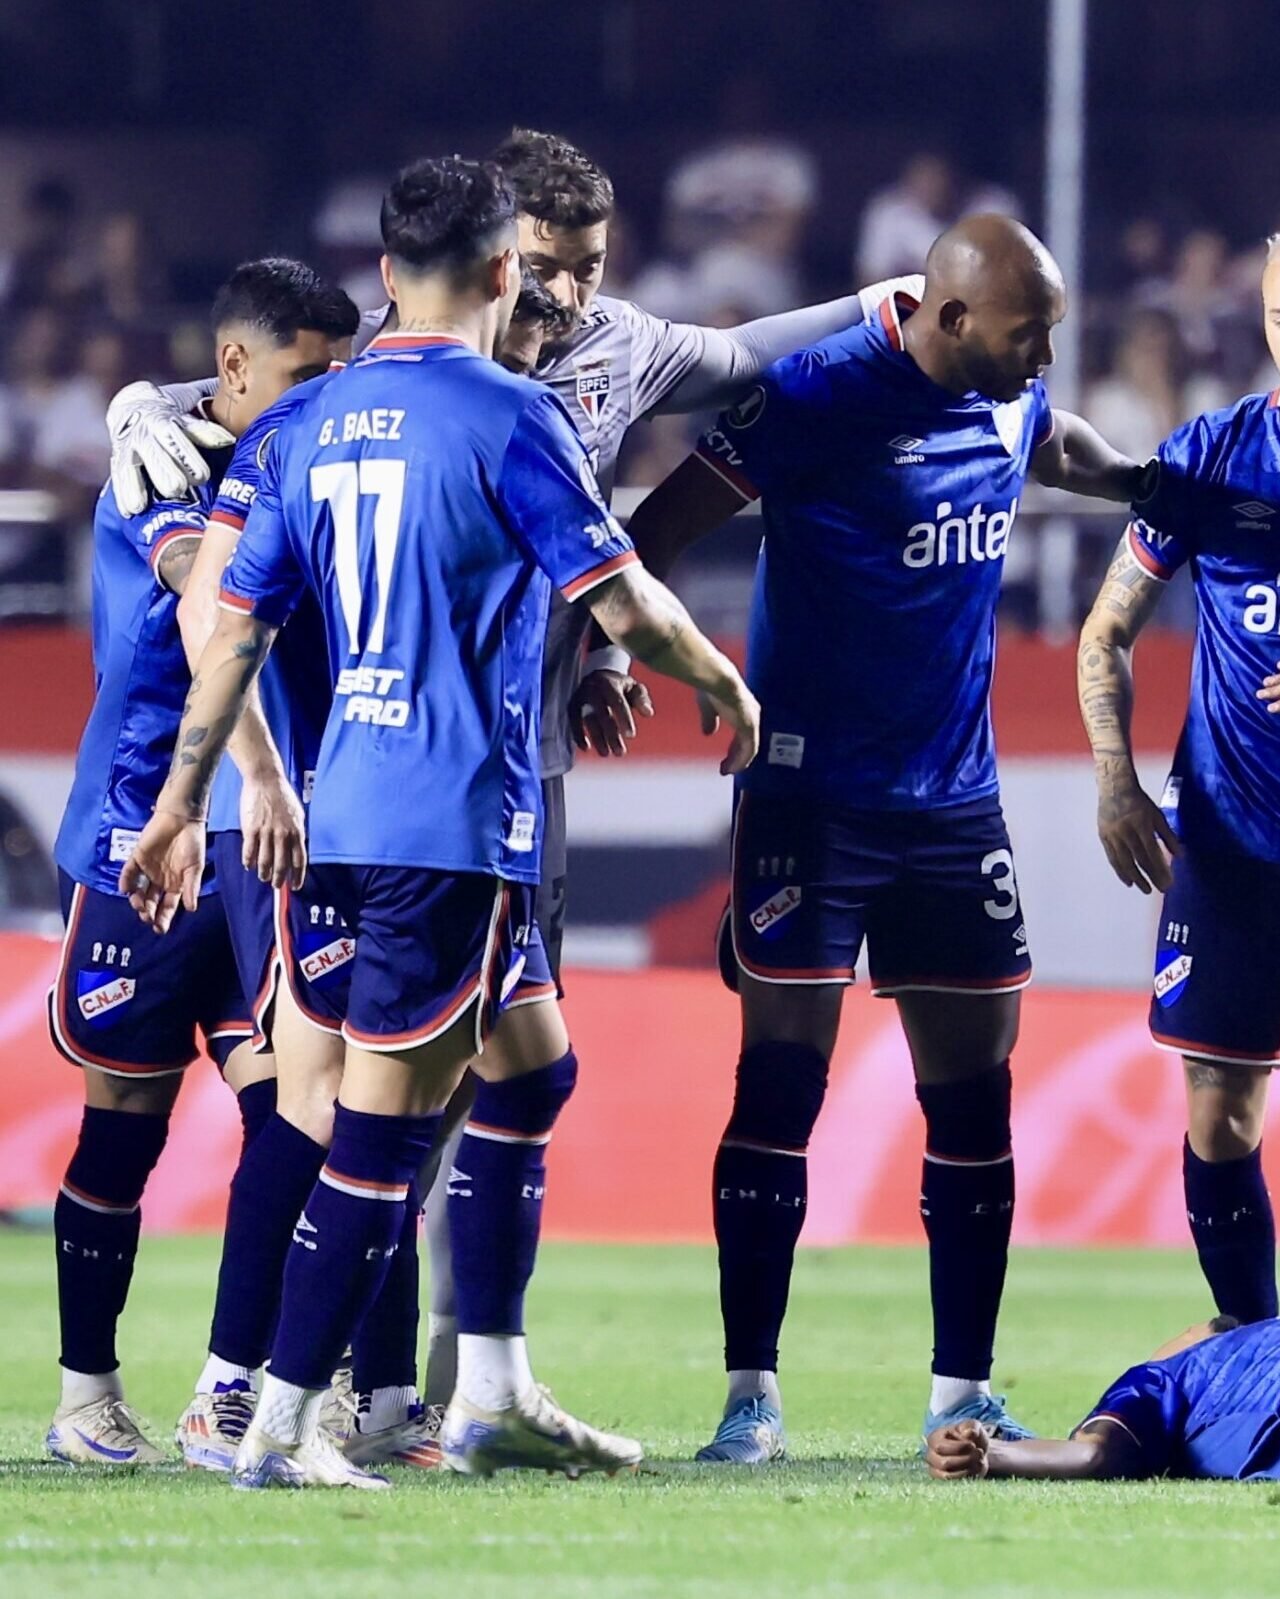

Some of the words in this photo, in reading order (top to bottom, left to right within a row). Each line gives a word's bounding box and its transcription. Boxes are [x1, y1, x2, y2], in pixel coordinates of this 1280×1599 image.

[579, 377, 609, 393] SPFC
[318, 418, 339, 447] G.
[342, 408, 406, 443] BAEZ
[895, 453, 925, 465] umbro
[309, 458, 407, 655] 77
[902, 496, 1018, 569] antel
[981, 847, 1018, 920] 3
